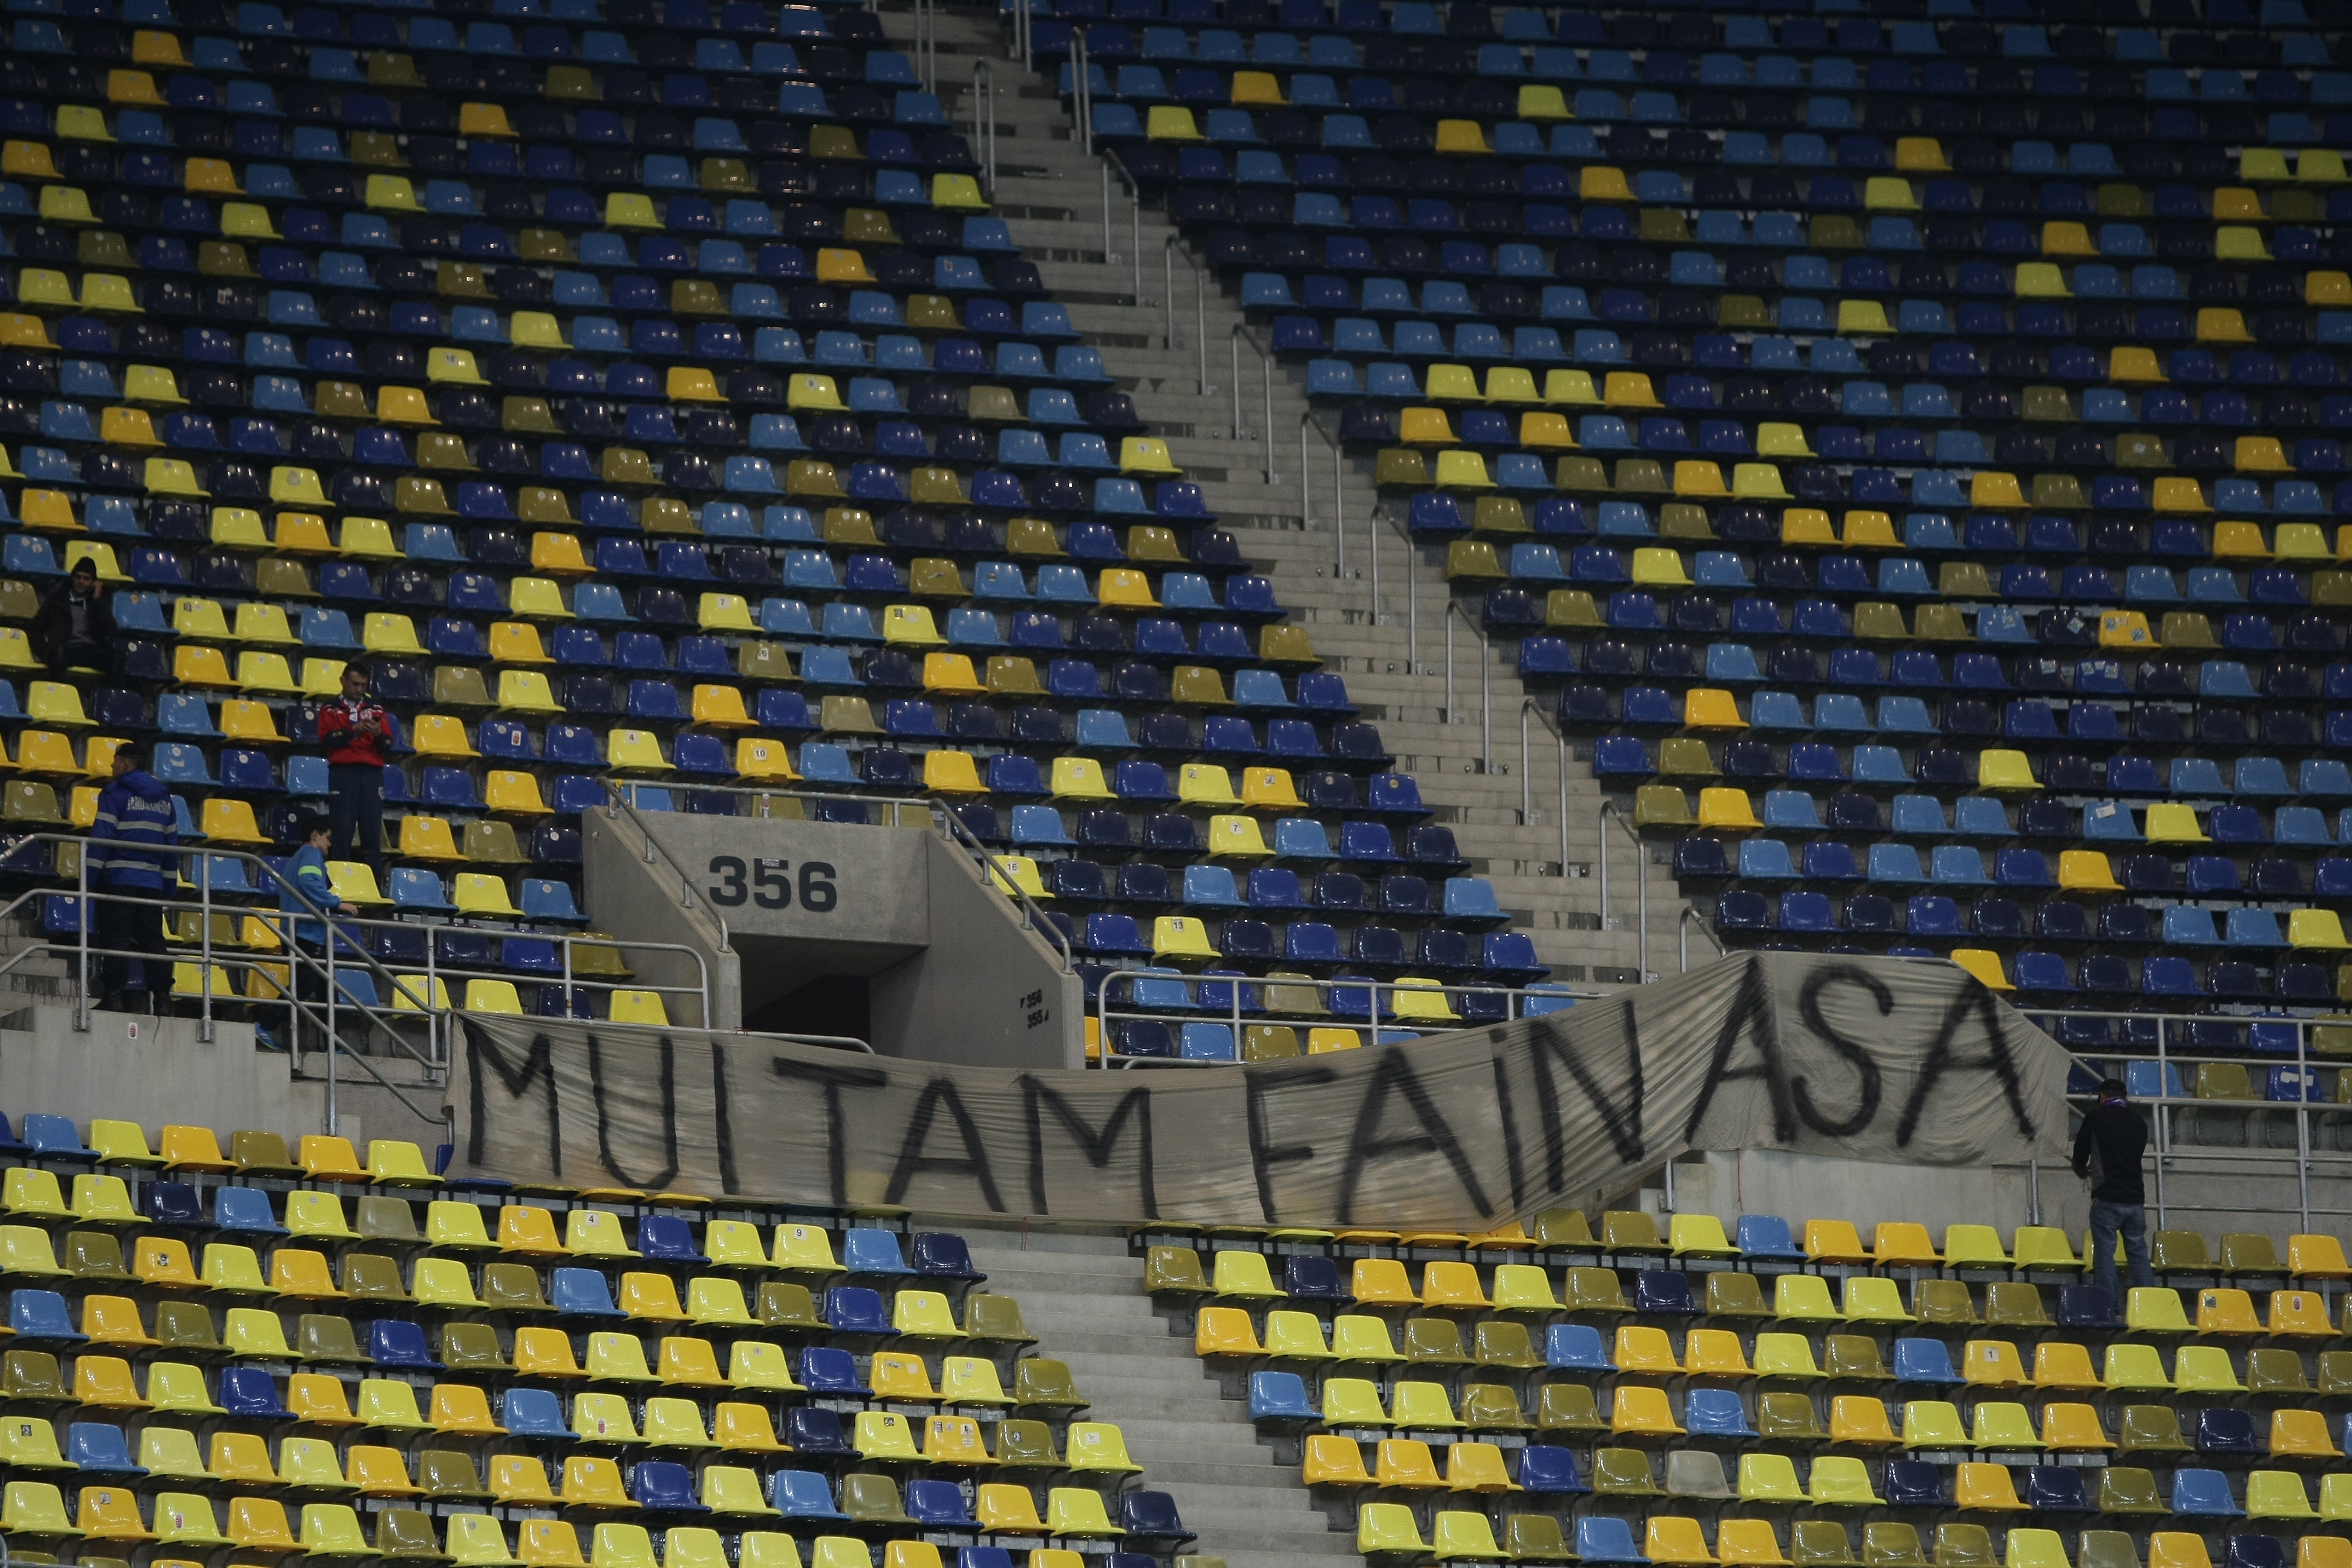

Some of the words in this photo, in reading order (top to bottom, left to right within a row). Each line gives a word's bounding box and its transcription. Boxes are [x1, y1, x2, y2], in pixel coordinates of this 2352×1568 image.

[756, 749, 766, 757] 10
[1232, 823, 1238, 831] 7
[710, 855, 837, 912] 356
[1173, 921, 1184, 930] 13
[1027, 988, 1042, 1009] 356
[1027, 1009, 1043, 1029] 355
[1684, 955, 2035, 1148] ASA
[589, 1215, 595, 1223] 4
[796, 1229, 802, 1237] 9
[1988, 1350, 1993, 1359] 1
